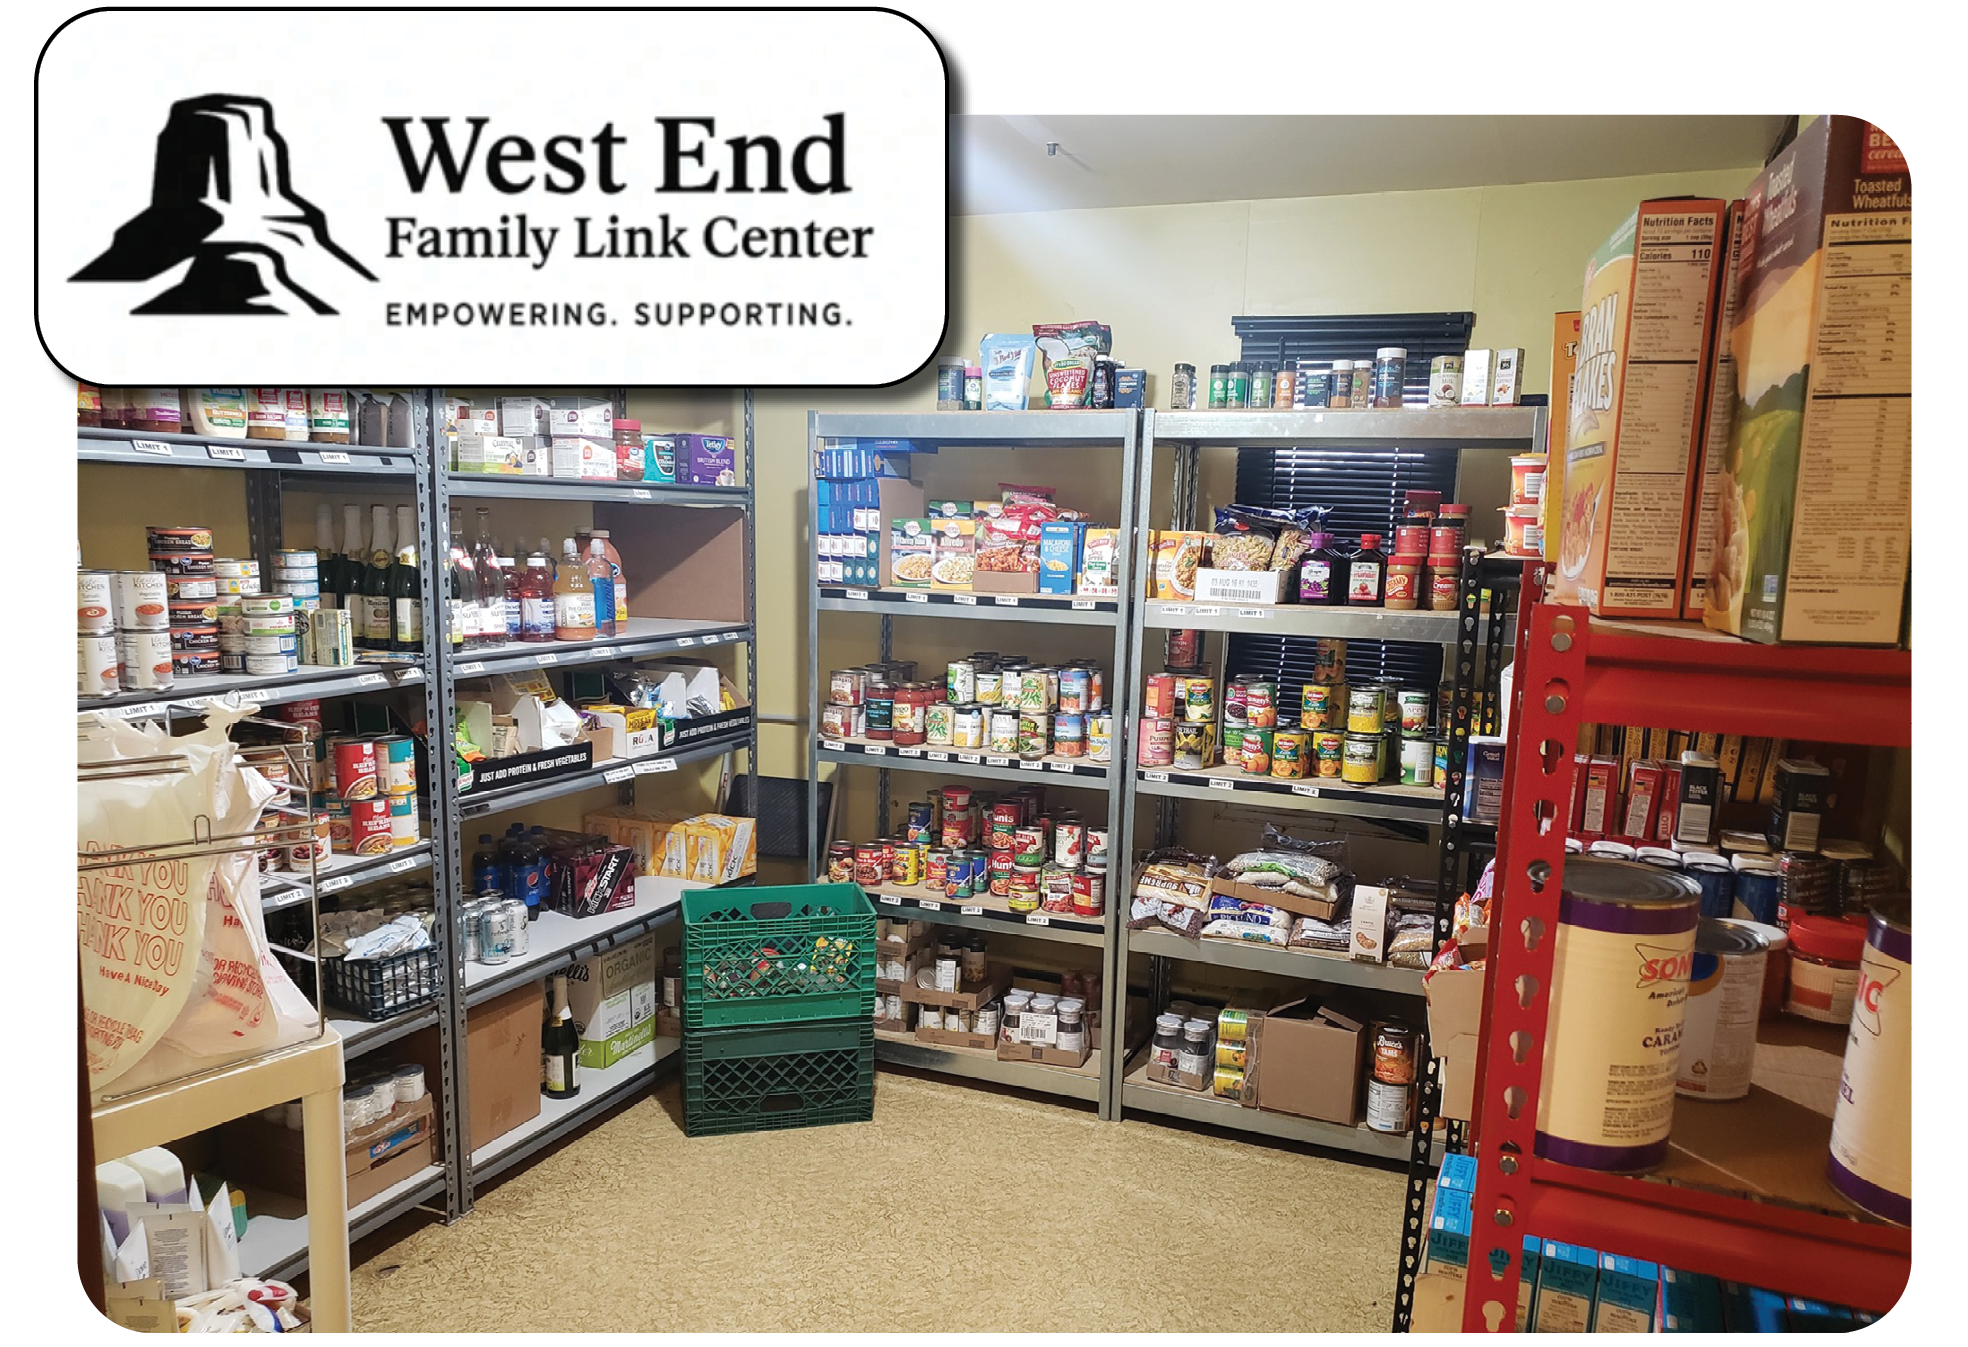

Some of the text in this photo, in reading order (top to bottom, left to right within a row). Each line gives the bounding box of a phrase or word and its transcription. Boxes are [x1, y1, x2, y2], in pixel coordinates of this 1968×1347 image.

[1854, 178, 1902, 193] Toasted
[1644, 216, 1714, 226] Nutrition Facts
[1830, 218, 1897, 228] Nutrition
[1640, 248, 1711, 260] Calories 110
[1582, 292, 1618, 360] BRAN
[1050, 370, 1086, 379] UNSWEETENED
[1050, 377, 1084, 386] COCONUT
[1053, 382, 1080, 390] FLAKES
[136, 441, 160, 450] LIMIT
[706, 440, 722, 450] Tetley
[212, 448, 233, 456] LIMIT
[1218, 578, 1231, 586] AUG
[1433, 582, 1456, 590] Creamy
[238, 692, 258, 700] LIMIT
[125, 707, 148, 716] LIMIT
[679, 730, 690, 739] JUST
[690, 728, 698, 736] ADD
[698, 724, 713, 735] PROTEIN
[717, 720, 728, 730] FRESH
[480, 752, 587, 782] JUST ADD PROTEIN & FRESH VEGETABLES
[1294, 786, 1310, 794] LIMIT
[391, 860, 408, 870] LIMIT
[136, 851, 188, 895] YOU
[326, 878, 344, 888] LIMIT
[1140, 876, 1178, 890] SUPREME
[277, 892, 296, 902] LIMIT
[138, 889, 187, 936] YOU
[134, 929, 184, 976] YOU
[606, 948, 652, 978] ORGANIC
[1457, 1155, 1470, 1184] JIFFY
[1452, 1190, 1464, 1220] JIFFY
[1544, 1261, 1591, 1280] JIFFY
[1602, 1276, 1651, 1294] JIFFY
